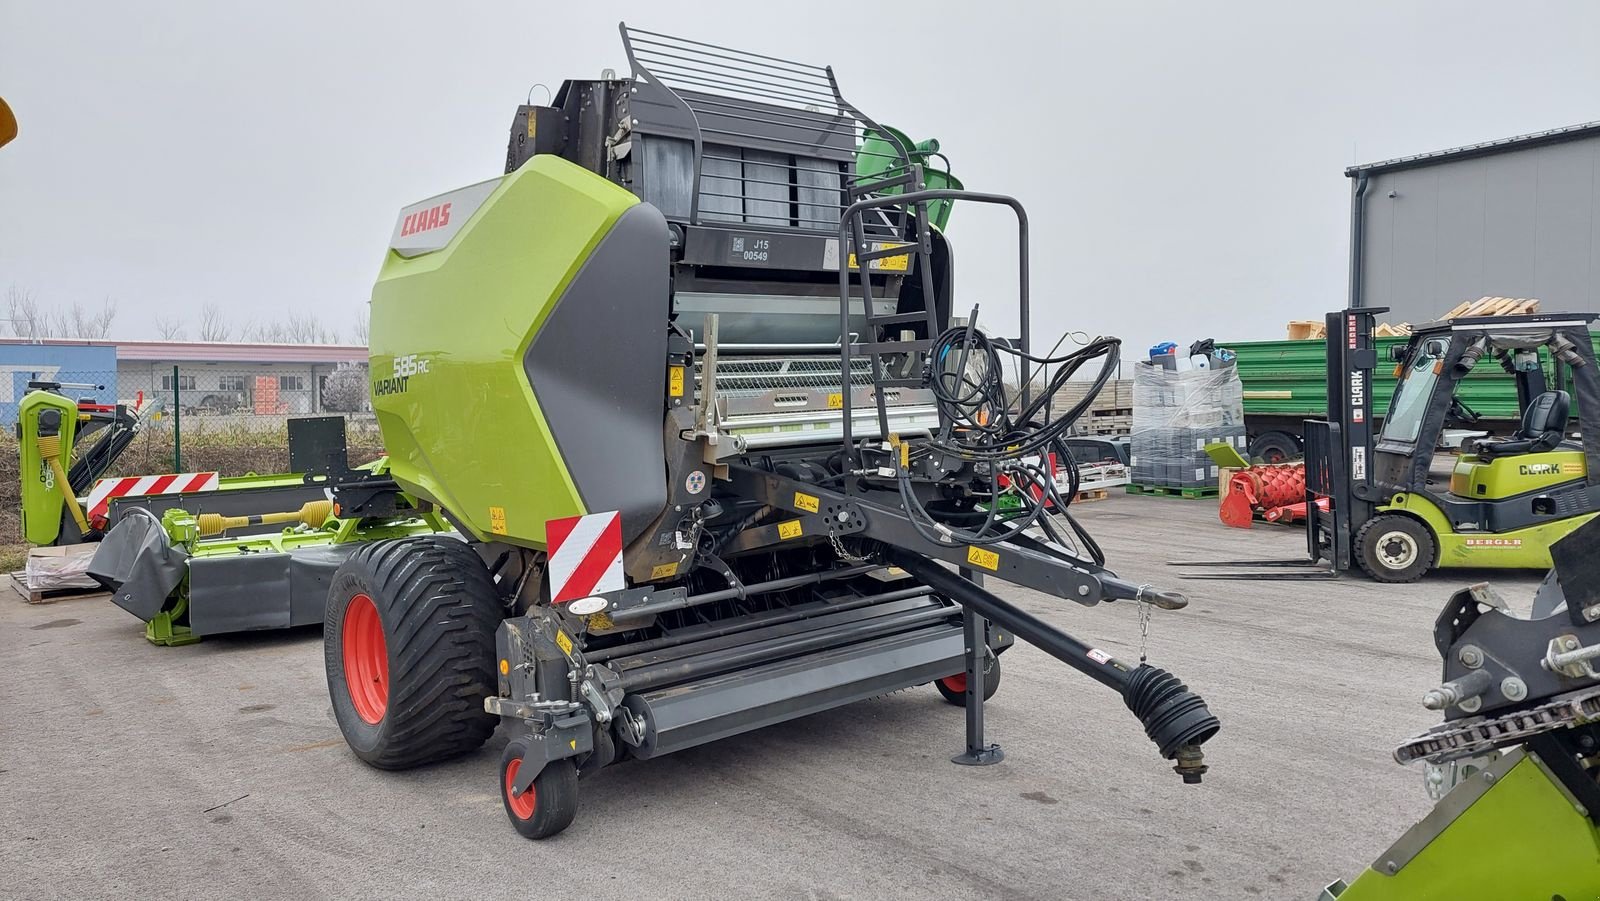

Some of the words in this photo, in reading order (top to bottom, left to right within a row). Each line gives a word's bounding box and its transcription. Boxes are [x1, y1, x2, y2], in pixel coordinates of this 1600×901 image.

[401, 203, 451, 236] CLAAS
[754, 240, 768, 249] J15
[744, 250, 768, 260] 00549
[394, 354, 417, 378] 585
[418, 360, 430, 374] RC
[374, 376, 408, 396] VARIANT
[1350, 370, 1363, 406] CLARK
[1519, 463, 1560, 475] CLARK
